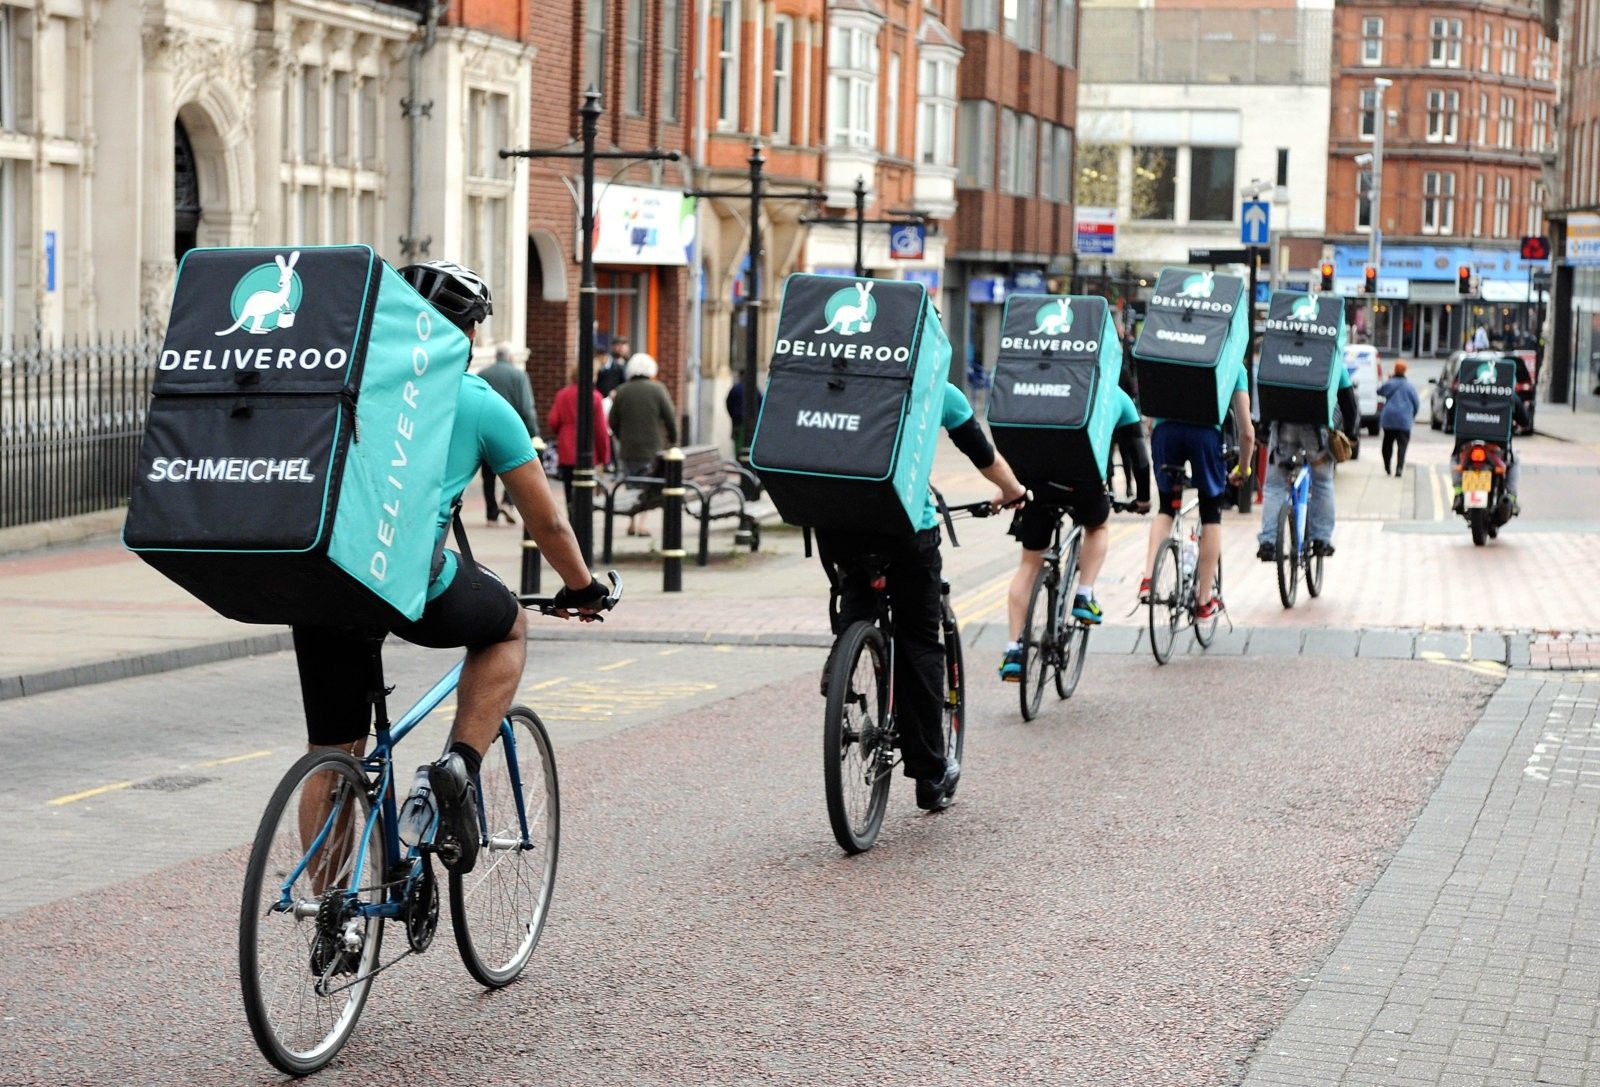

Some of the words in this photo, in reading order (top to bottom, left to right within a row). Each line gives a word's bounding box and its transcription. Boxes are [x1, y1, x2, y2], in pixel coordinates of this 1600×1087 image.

[1152, 295, 1233, 314] DELIVEROO
[1266, 319, 1337, 337] DELIVEROO
[775, 339, 909, 362] DELIVEROO
[1001, 337, 1098, 352] DELIVEROO
[159, 348, 348, 370] DELIVEROO
[1277, 354, 1312, 367] VARDY
[1013, 382, 1071, 397] MAHREZ
[1458, 383, 1512, 396] DELIVEROO
[796, 410, 860, 431] KANTE
[370, 311, 432, 582] DELIVEROO
[147, 457, 315, 483] SCHMEICHEL
[1471, 491, 1481, 504] L
